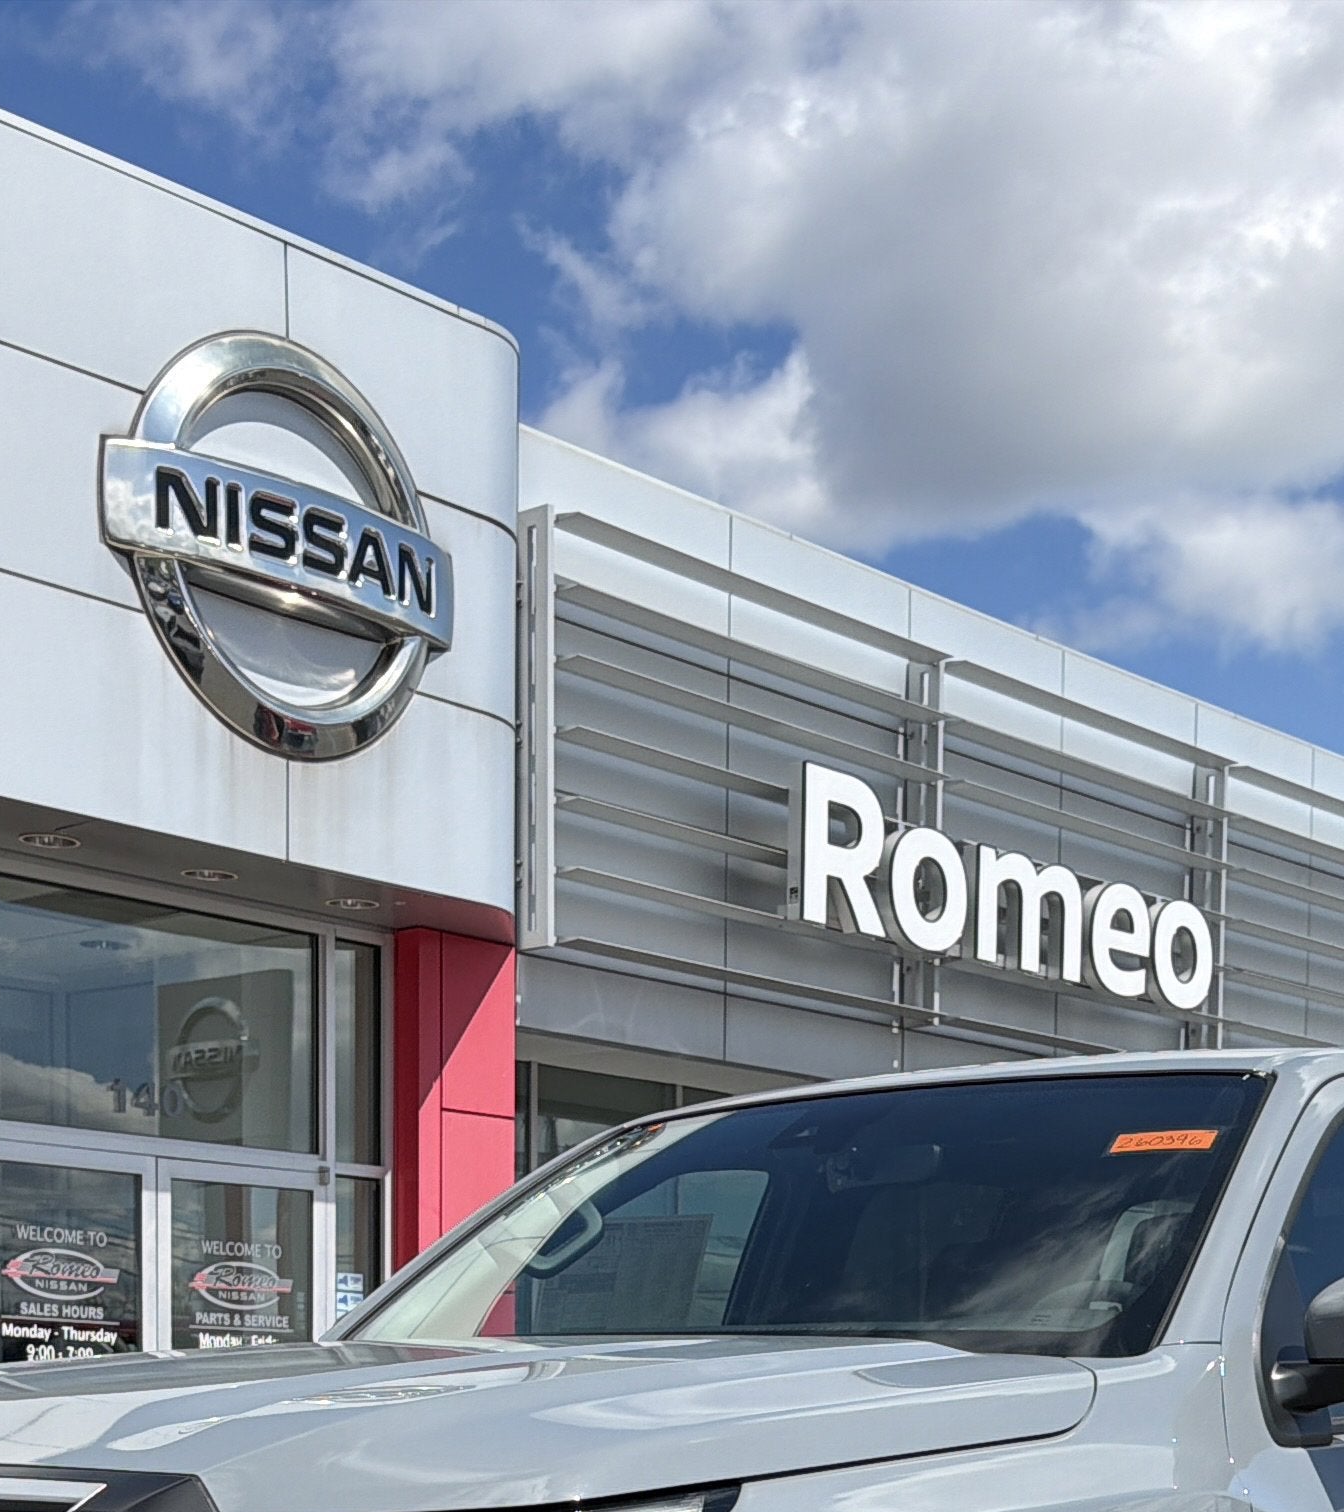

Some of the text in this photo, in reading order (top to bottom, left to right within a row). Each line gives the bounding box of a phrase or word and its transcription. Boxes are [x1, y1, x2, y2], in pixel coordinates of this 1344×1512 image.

[154, 465, 437, 619] NISSAN
[800, 760, 1213, 1010] Romeo
[111, 1078, 184, 1118] 140
[16, 1223, 108, 1248] WELCOME TO
[201, 1240, 283, 1260] WELCOME TO
[27, 1251, 101, 1279] Romeo
[212, 1264, 277, 1288] Romeo
[36, 1278, 88, 1292] NISSAN
[218, 1290, 266, 1302] NISSAN
[20, 1301, 104, 1320] SALES HOURS
[195, 1312, 290, 1328] PARTS & SERVICE
[1, 1322, 52, 1343] Monday
[61, 1325, 118, 1346] Thursday
[26, 1344, 56, 1361] 9:00
[66, 1345, 94, 1359] 7:00
